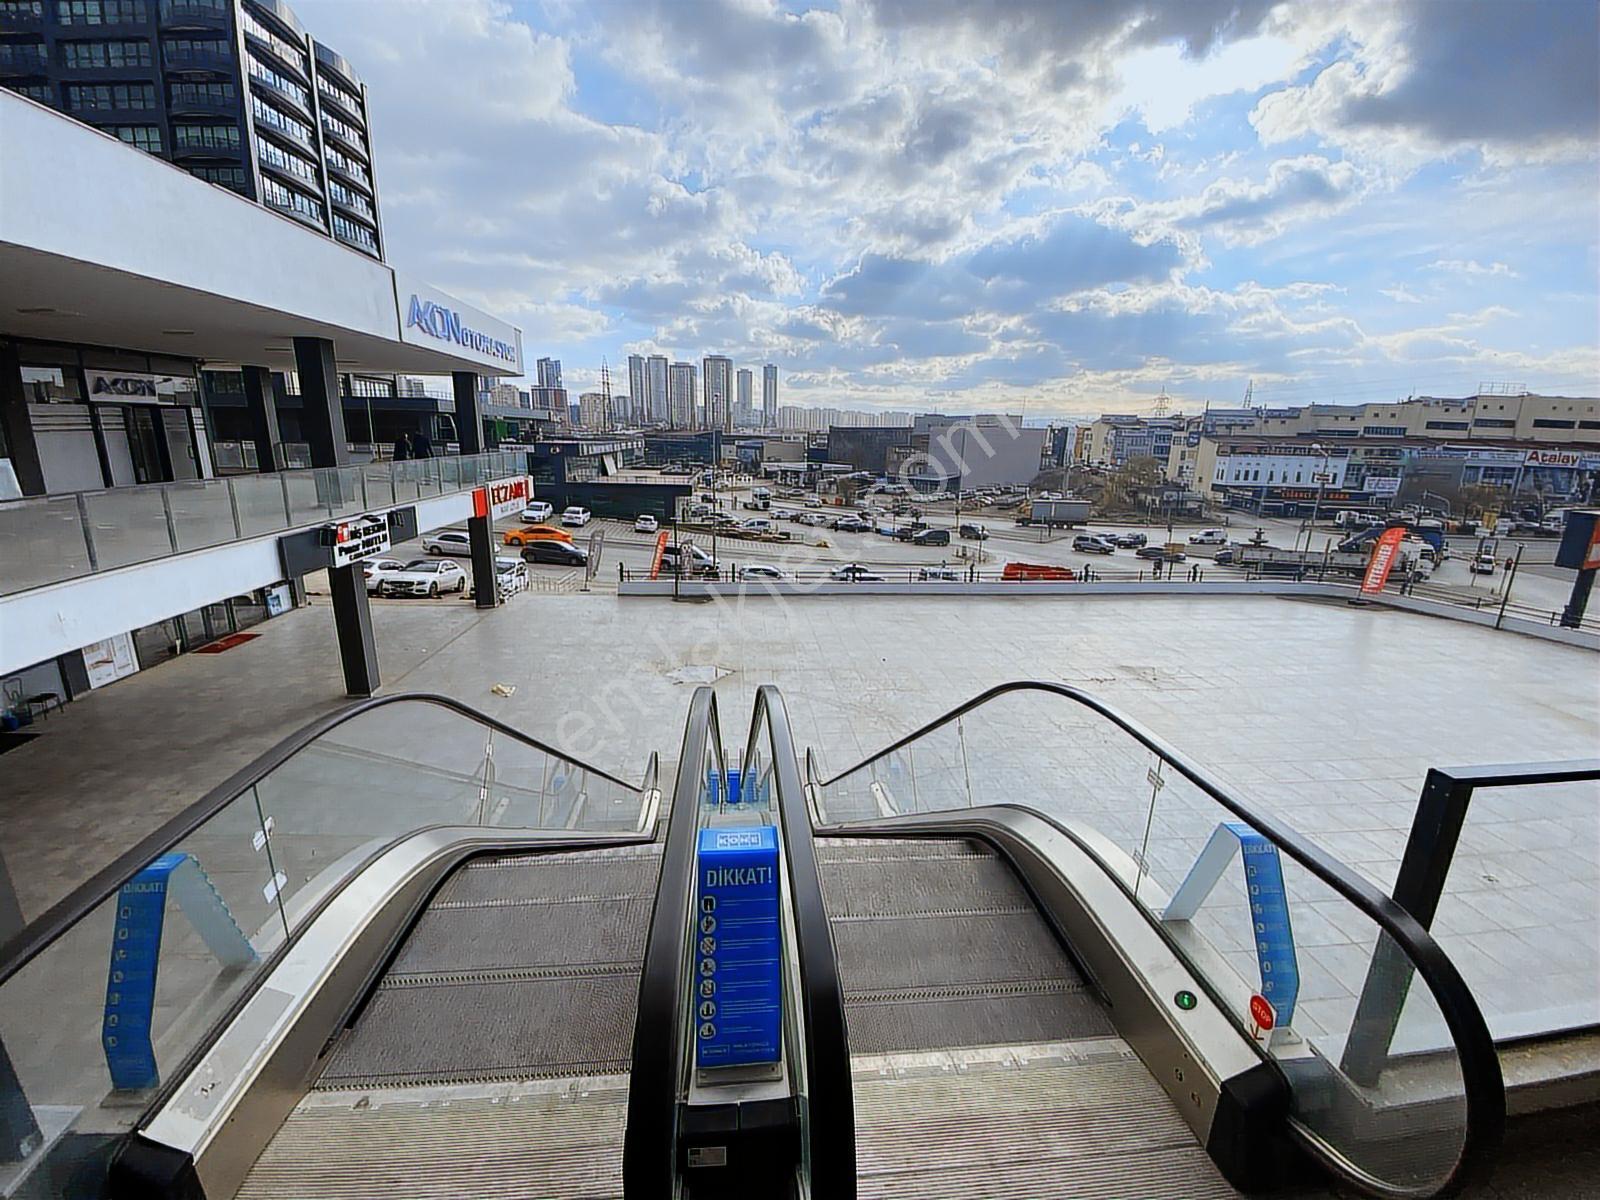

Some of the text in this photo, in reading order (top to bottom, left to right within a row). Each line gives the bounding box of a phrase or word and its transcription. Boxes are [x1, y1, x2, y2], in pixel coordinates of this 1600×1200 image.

[406, 294, 462, 345] AKON
[706, 865, 772, 887] DİKKAT!
[1251, 1001, 1271, 1023] STOP
